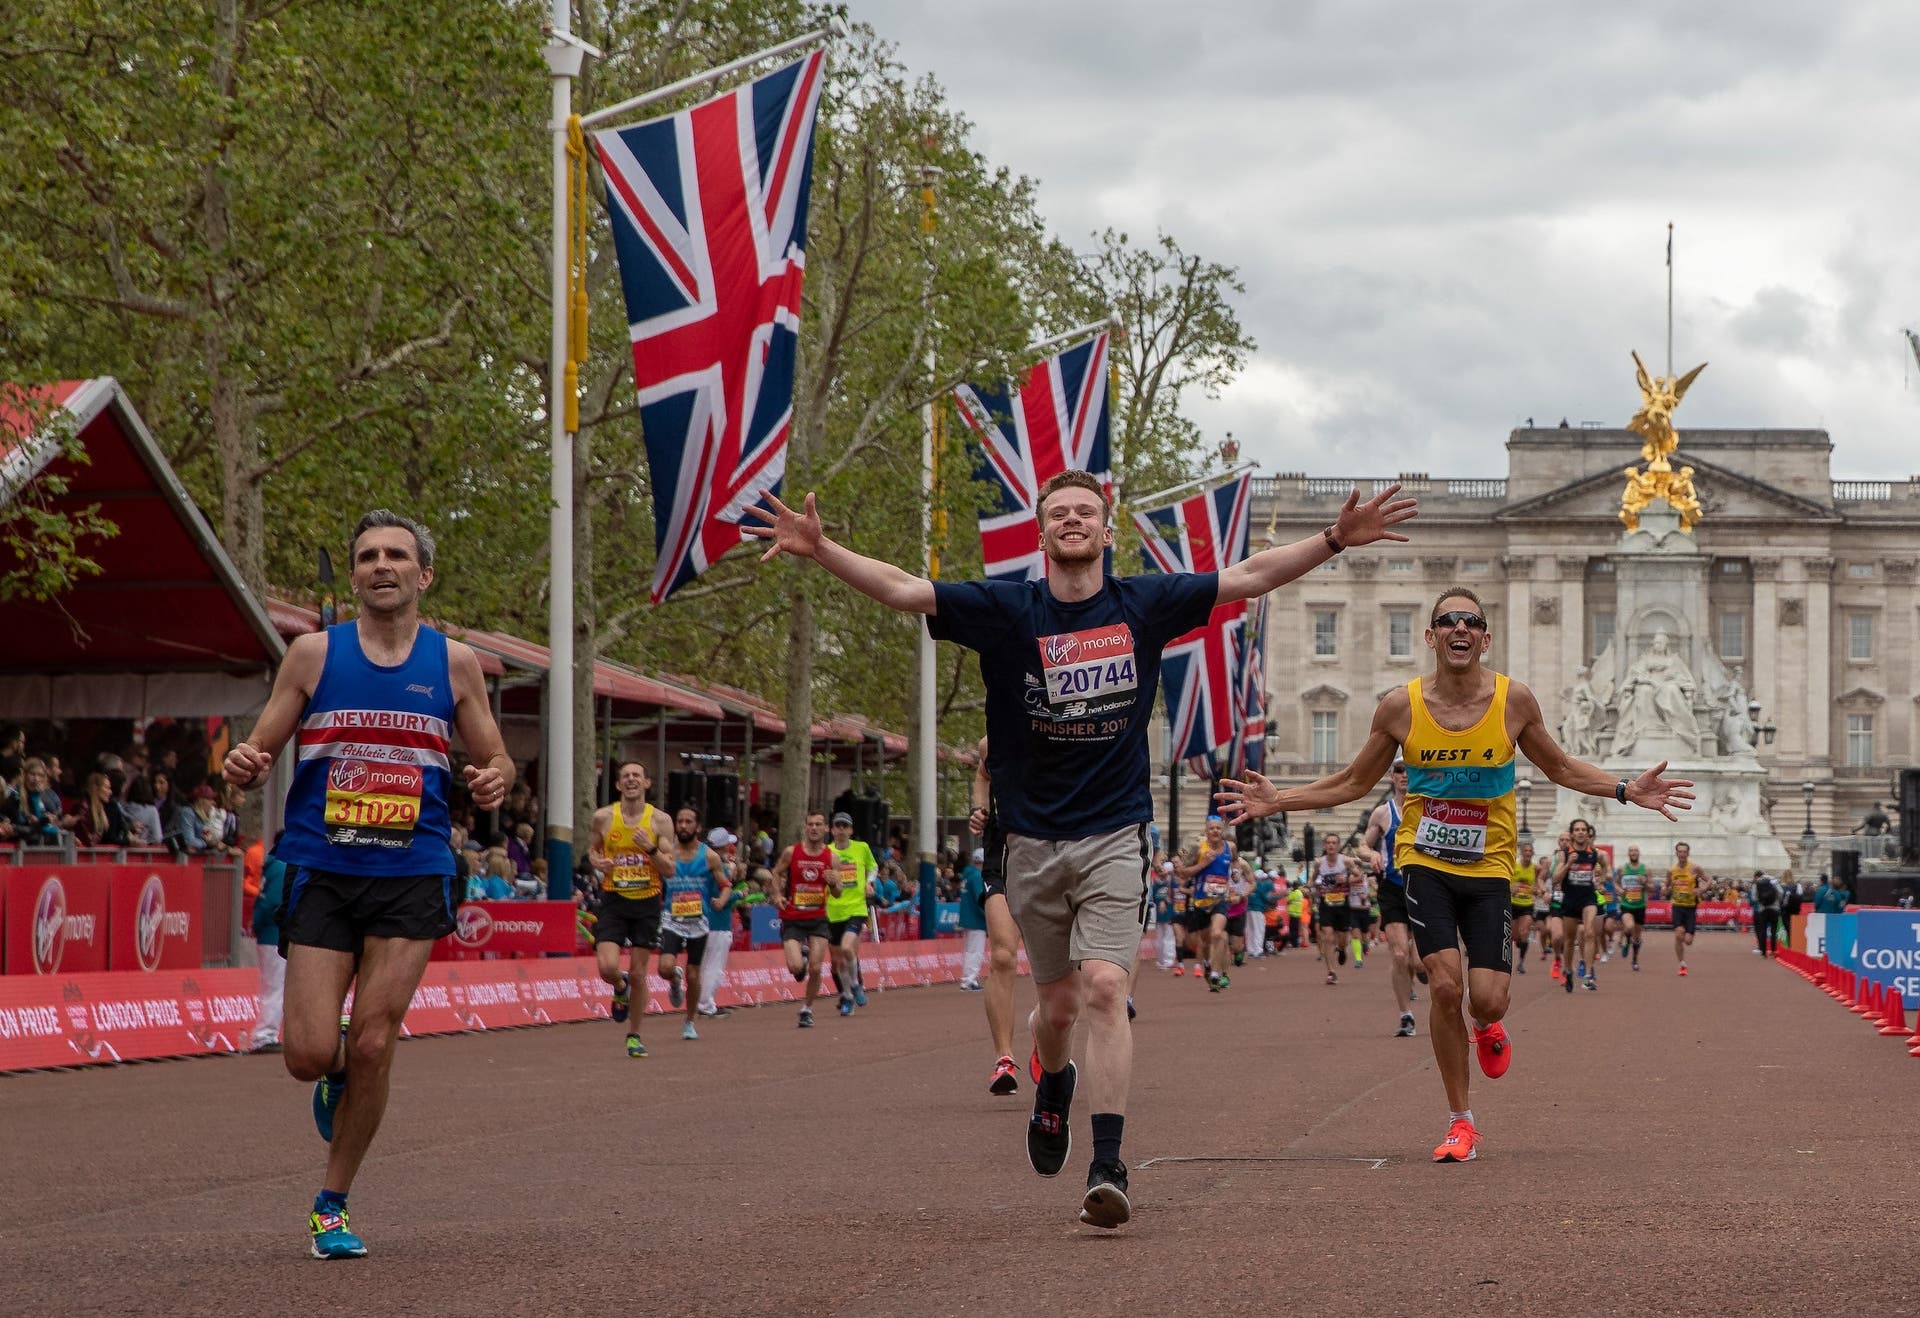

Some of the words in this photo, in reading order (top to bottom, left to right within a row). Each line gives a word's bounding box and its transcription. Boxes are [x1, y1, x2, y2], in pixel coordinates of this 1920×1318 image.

[1047, 635, 1077, 663] Virgin
[1083, 634, 1128, 650] money
[1057, 660, 1135, 696] 20744
[333, 711, 430, 732] NEWBURY
[1088, 706, 1102, 715] new
[1031, 719, 1096, 736] FINISHER
[1101, 718, 1129, 734] 2017
[342, 744, 386, 759] Athletic
[389, 749, 415, 762] Club
[1420, 748, 1472, 762] WEST
[1482, 748, 1494, 761] 4
[333, 760, 366, 790] Virgin
[371, 772, 419, 789] money
[335, 798, 416, 825] 31029
[1450, 808, 1486, 820] money
[1425, 823, 1482, 848] 59337
[64, 912, 97, 947] money
[494, 920, 544, 936] money
[1893, 975, 1920, 997] SE
[17, 1005, 62, 1035] PRIDE
[91, 1000, 146, 1032] LONDON
[144, 998, 183, 1026] PRIDE
[207, 997, 257, 1023] LONDON
